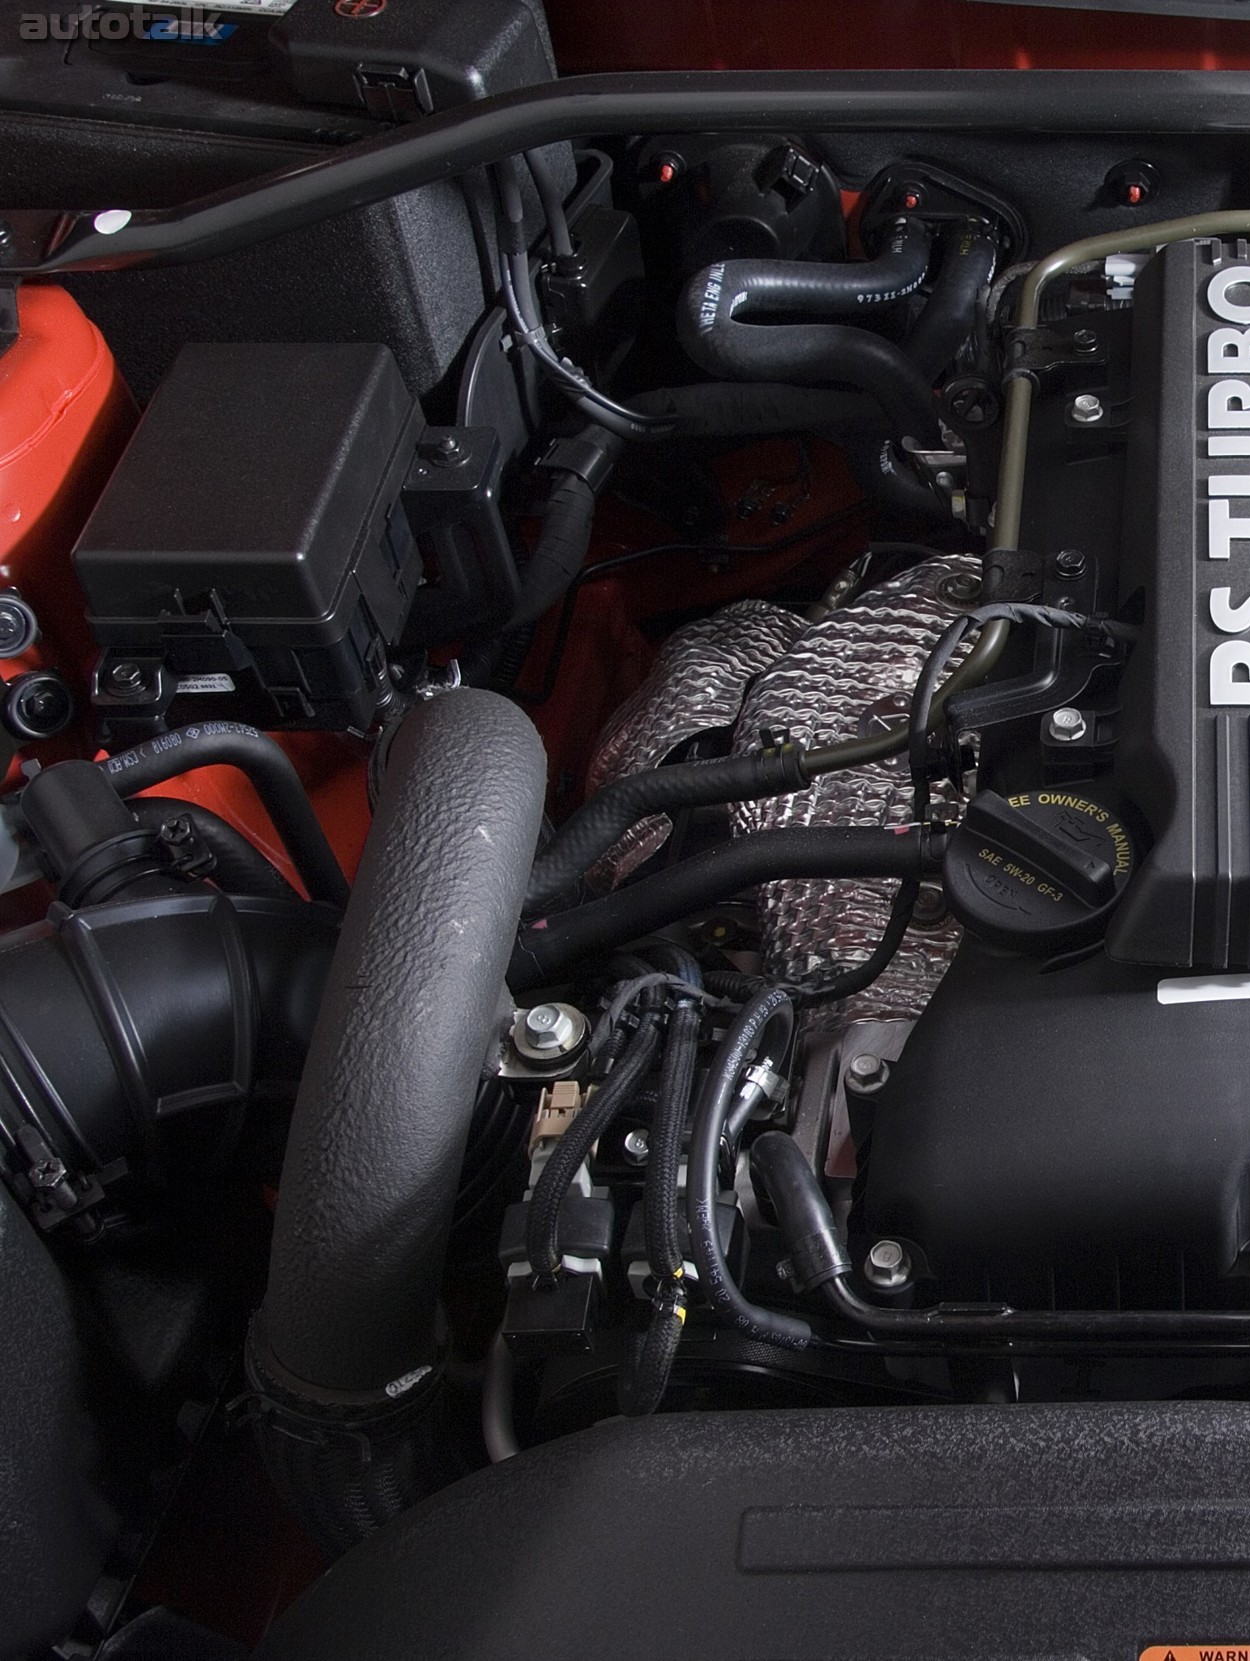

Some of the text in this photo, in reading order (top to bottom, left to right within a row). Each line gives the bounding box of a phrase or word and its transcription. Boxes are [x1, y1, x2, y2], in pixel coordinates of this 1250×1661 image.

[705, 282, 721, 301] ENG
[1008, 793, 1131, 876] EE OWNER'S MANUAL
[978, 848, 1064, 902] SAE 5W-20 GF-3
